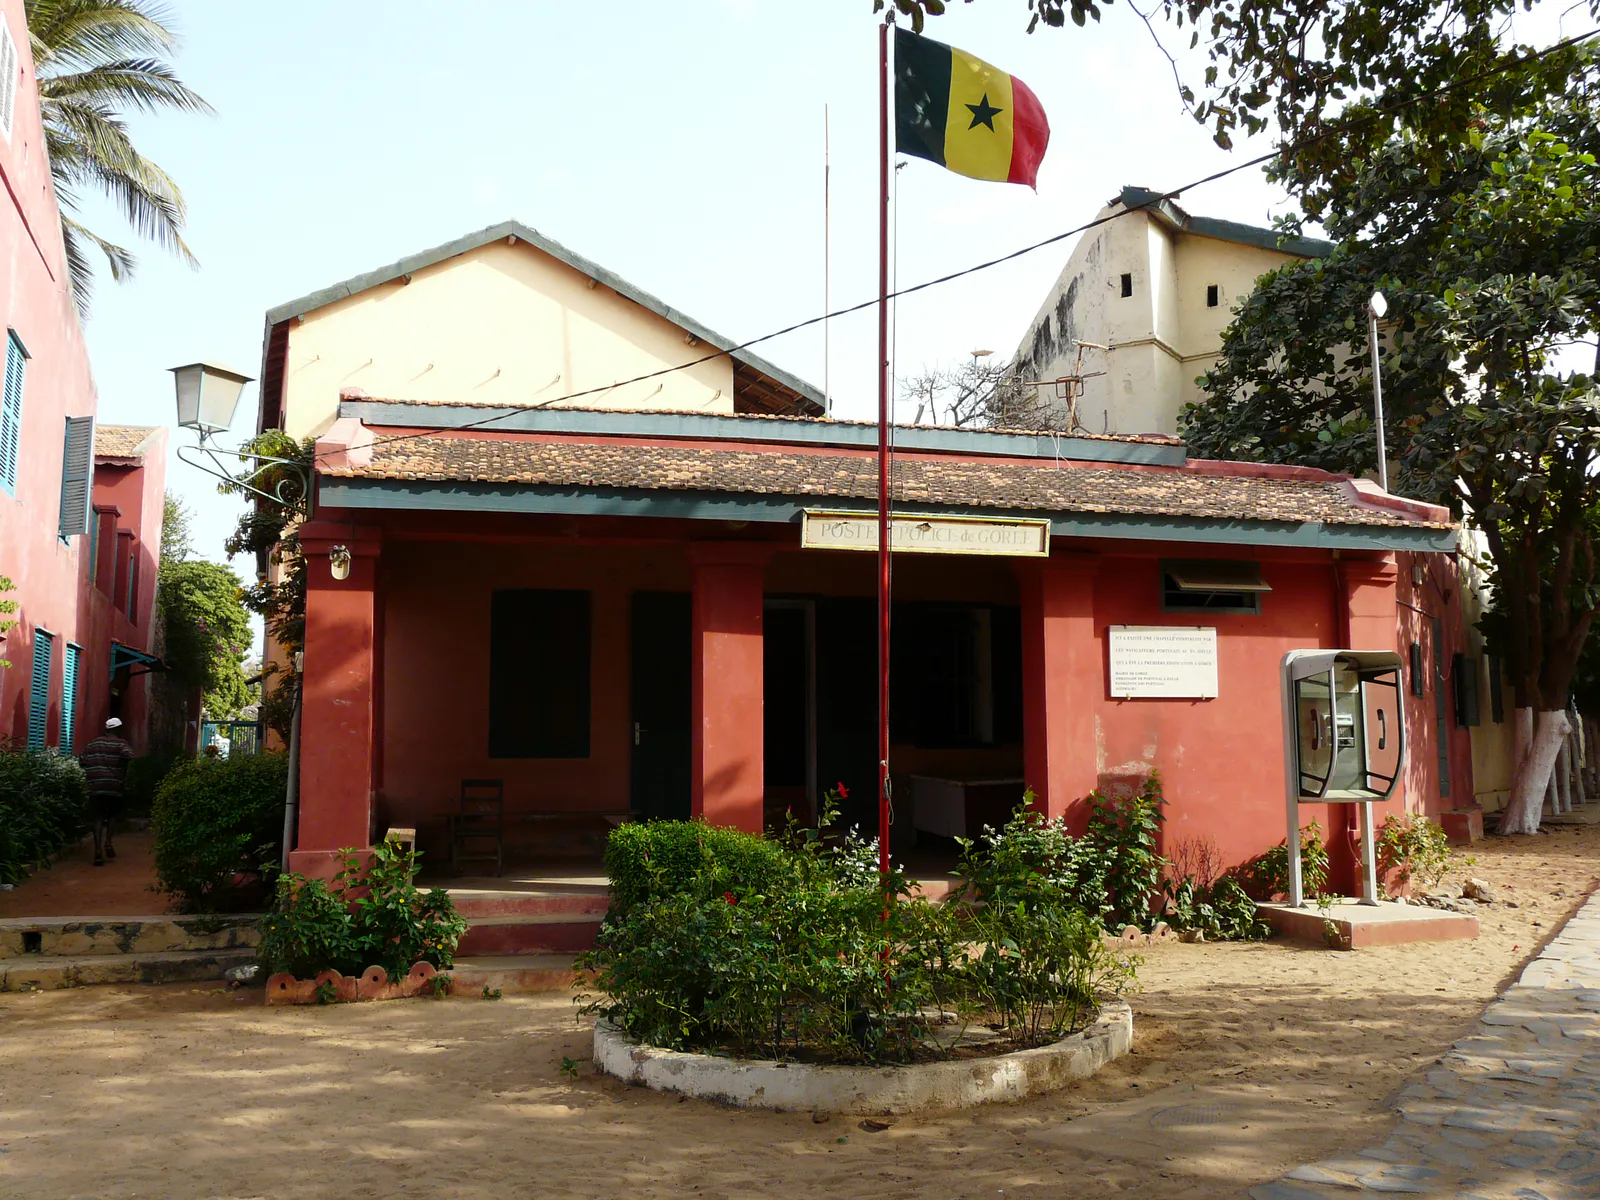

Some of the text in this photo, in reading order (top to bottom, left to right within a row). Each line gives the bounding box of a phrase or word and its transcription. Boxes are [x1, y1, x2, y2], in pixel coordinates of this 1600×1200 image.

[820, 522, 877, 539] POSTE
[898, 524, 957, 542] POLICE
[960, 527, 974, 543] de
